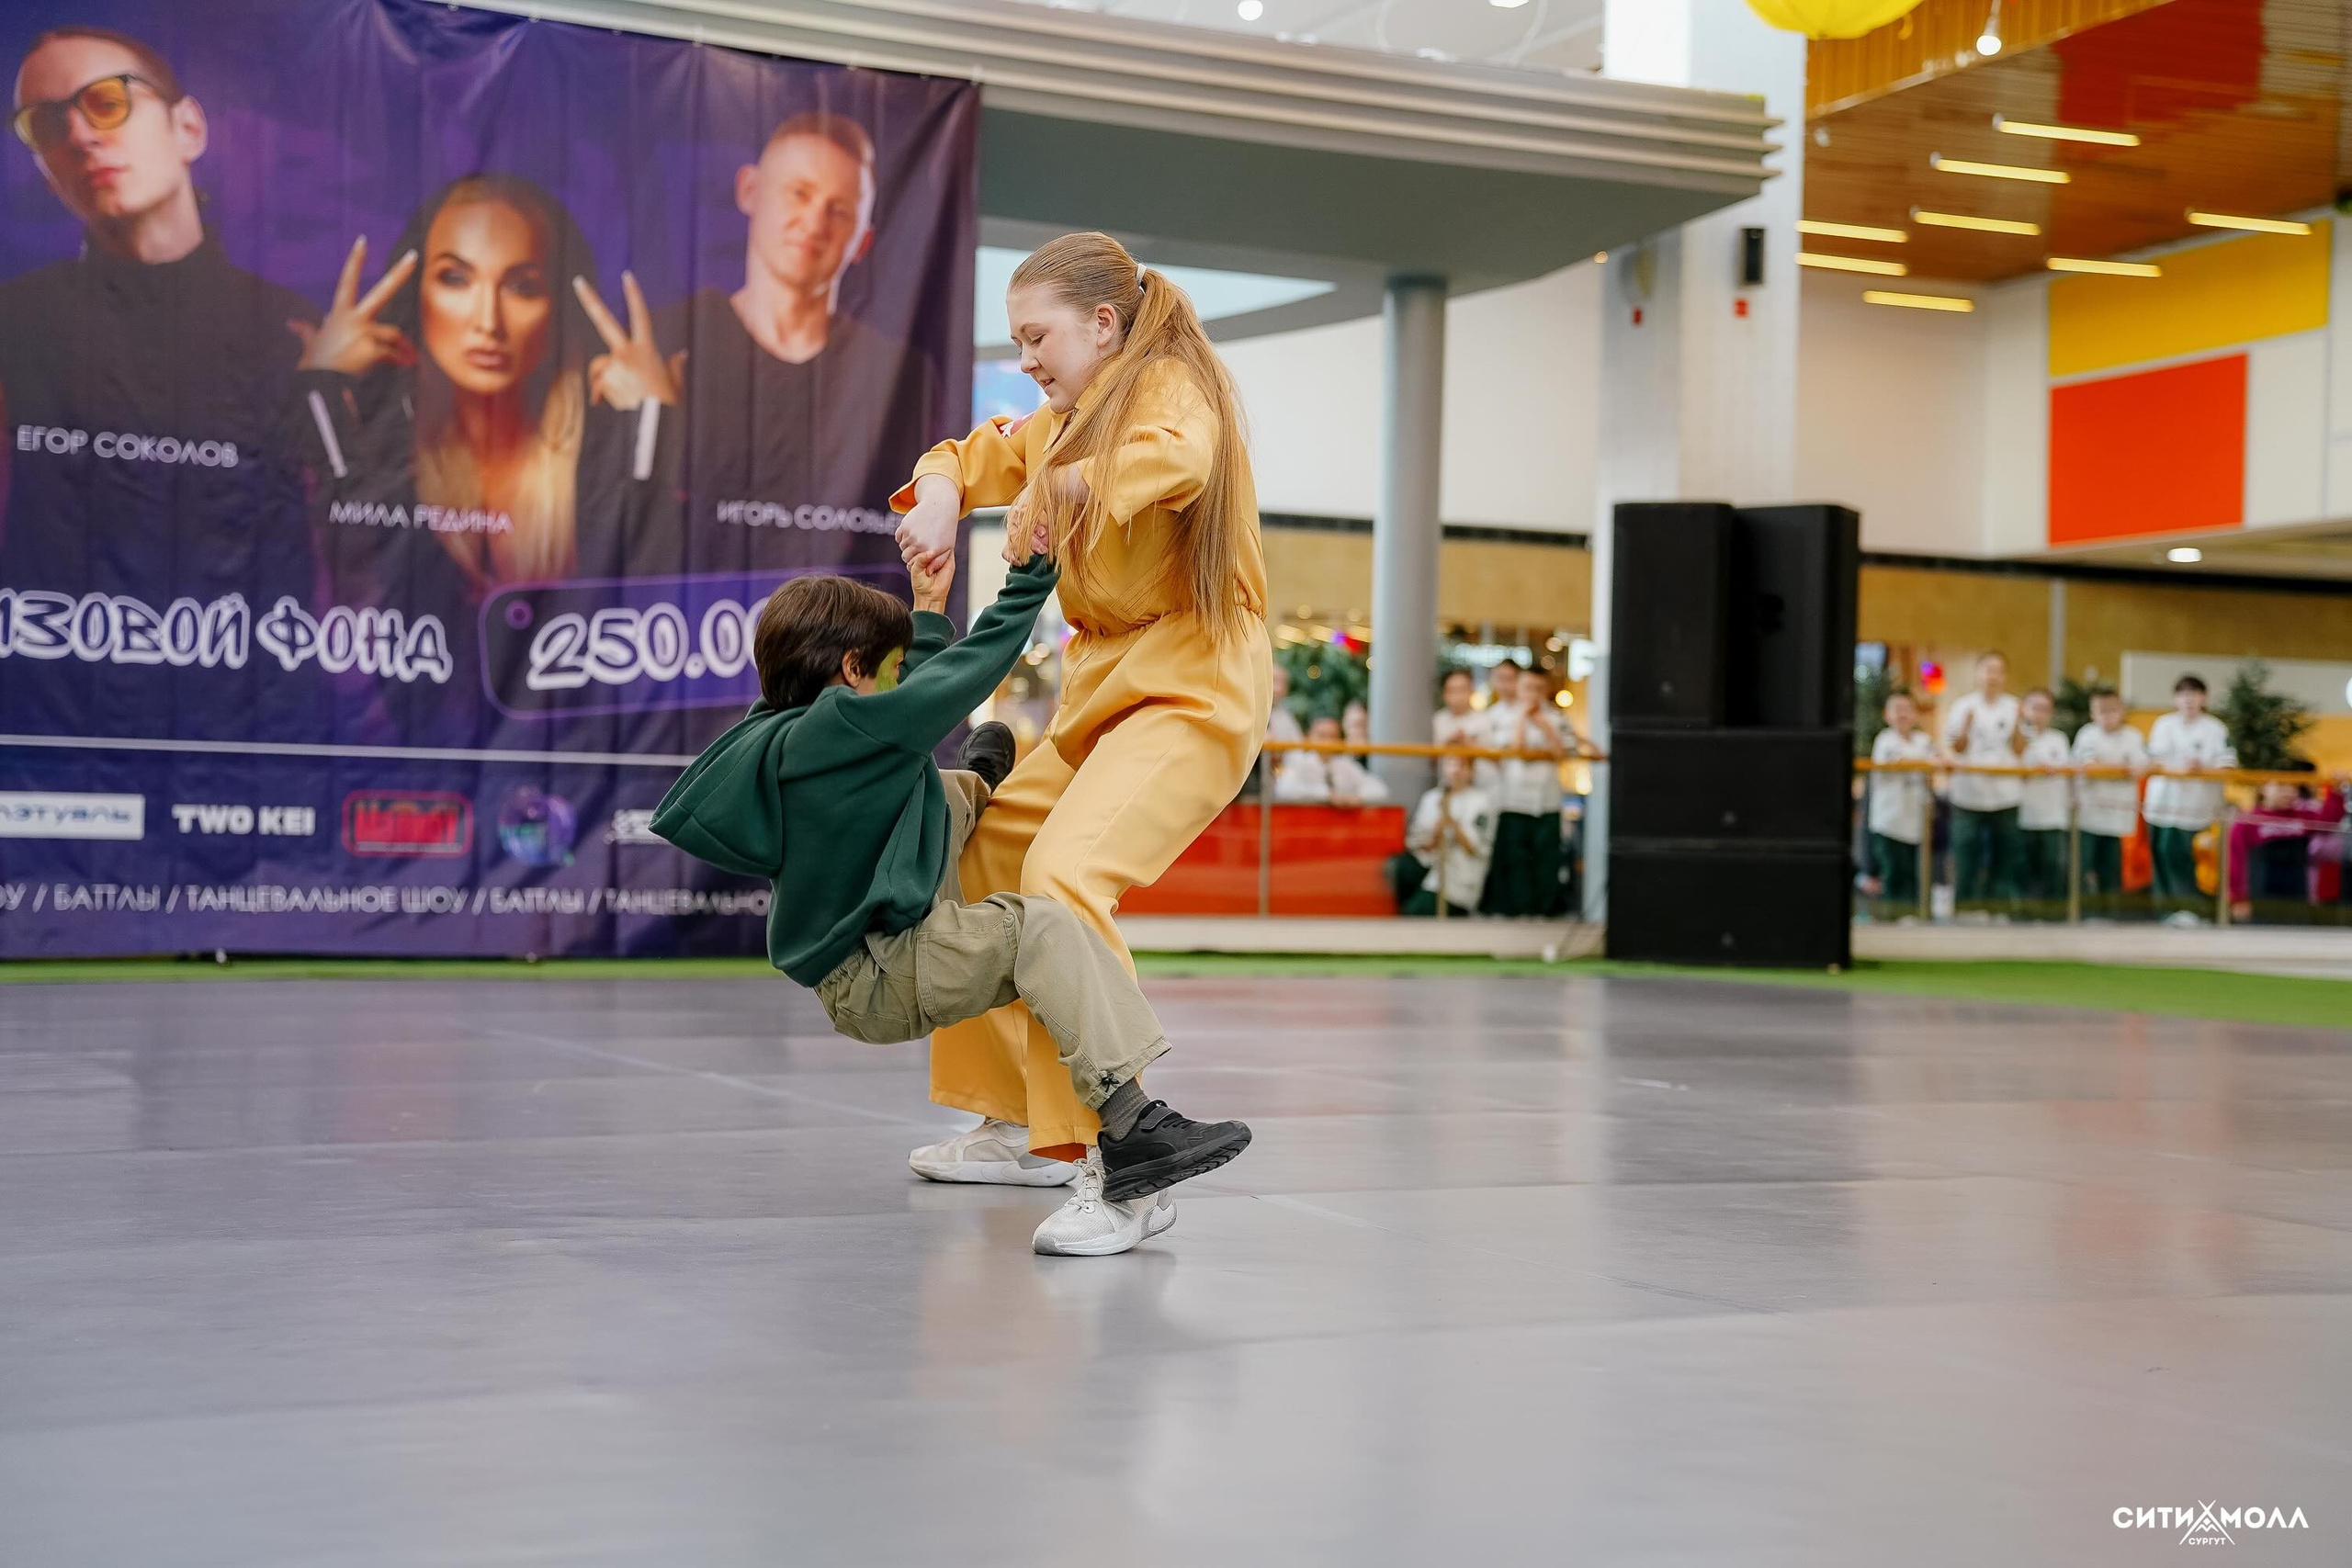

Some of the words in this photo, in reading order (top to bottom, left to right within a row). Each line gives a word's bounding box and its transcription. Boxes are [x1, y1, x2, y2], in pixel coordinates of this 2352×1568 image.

[17, 423, 89, 455] ЕГОР
[93, 430, 239, 468] СОКОЛОВ
[329, 499, 412, 530] МИЛА
[413, 503, 515, 535] РЕДИНА
[717, 498, 793, 529] ИГОРЬ
[794, 503, 908, 536] СОЛОВЬЕ
[171, 804, 254, 835] TWO
[258, 806, 316, 836] KEI
[53, 883, 161, 911] БАТТЛЫ
[185, 884, 399, 914] ТАНЦЕВАЛЬНОЕ
[401, 885, 469, 914] ШОУ
[604, 886, 773, 917] ТАНЦЕВАЛЬНО
